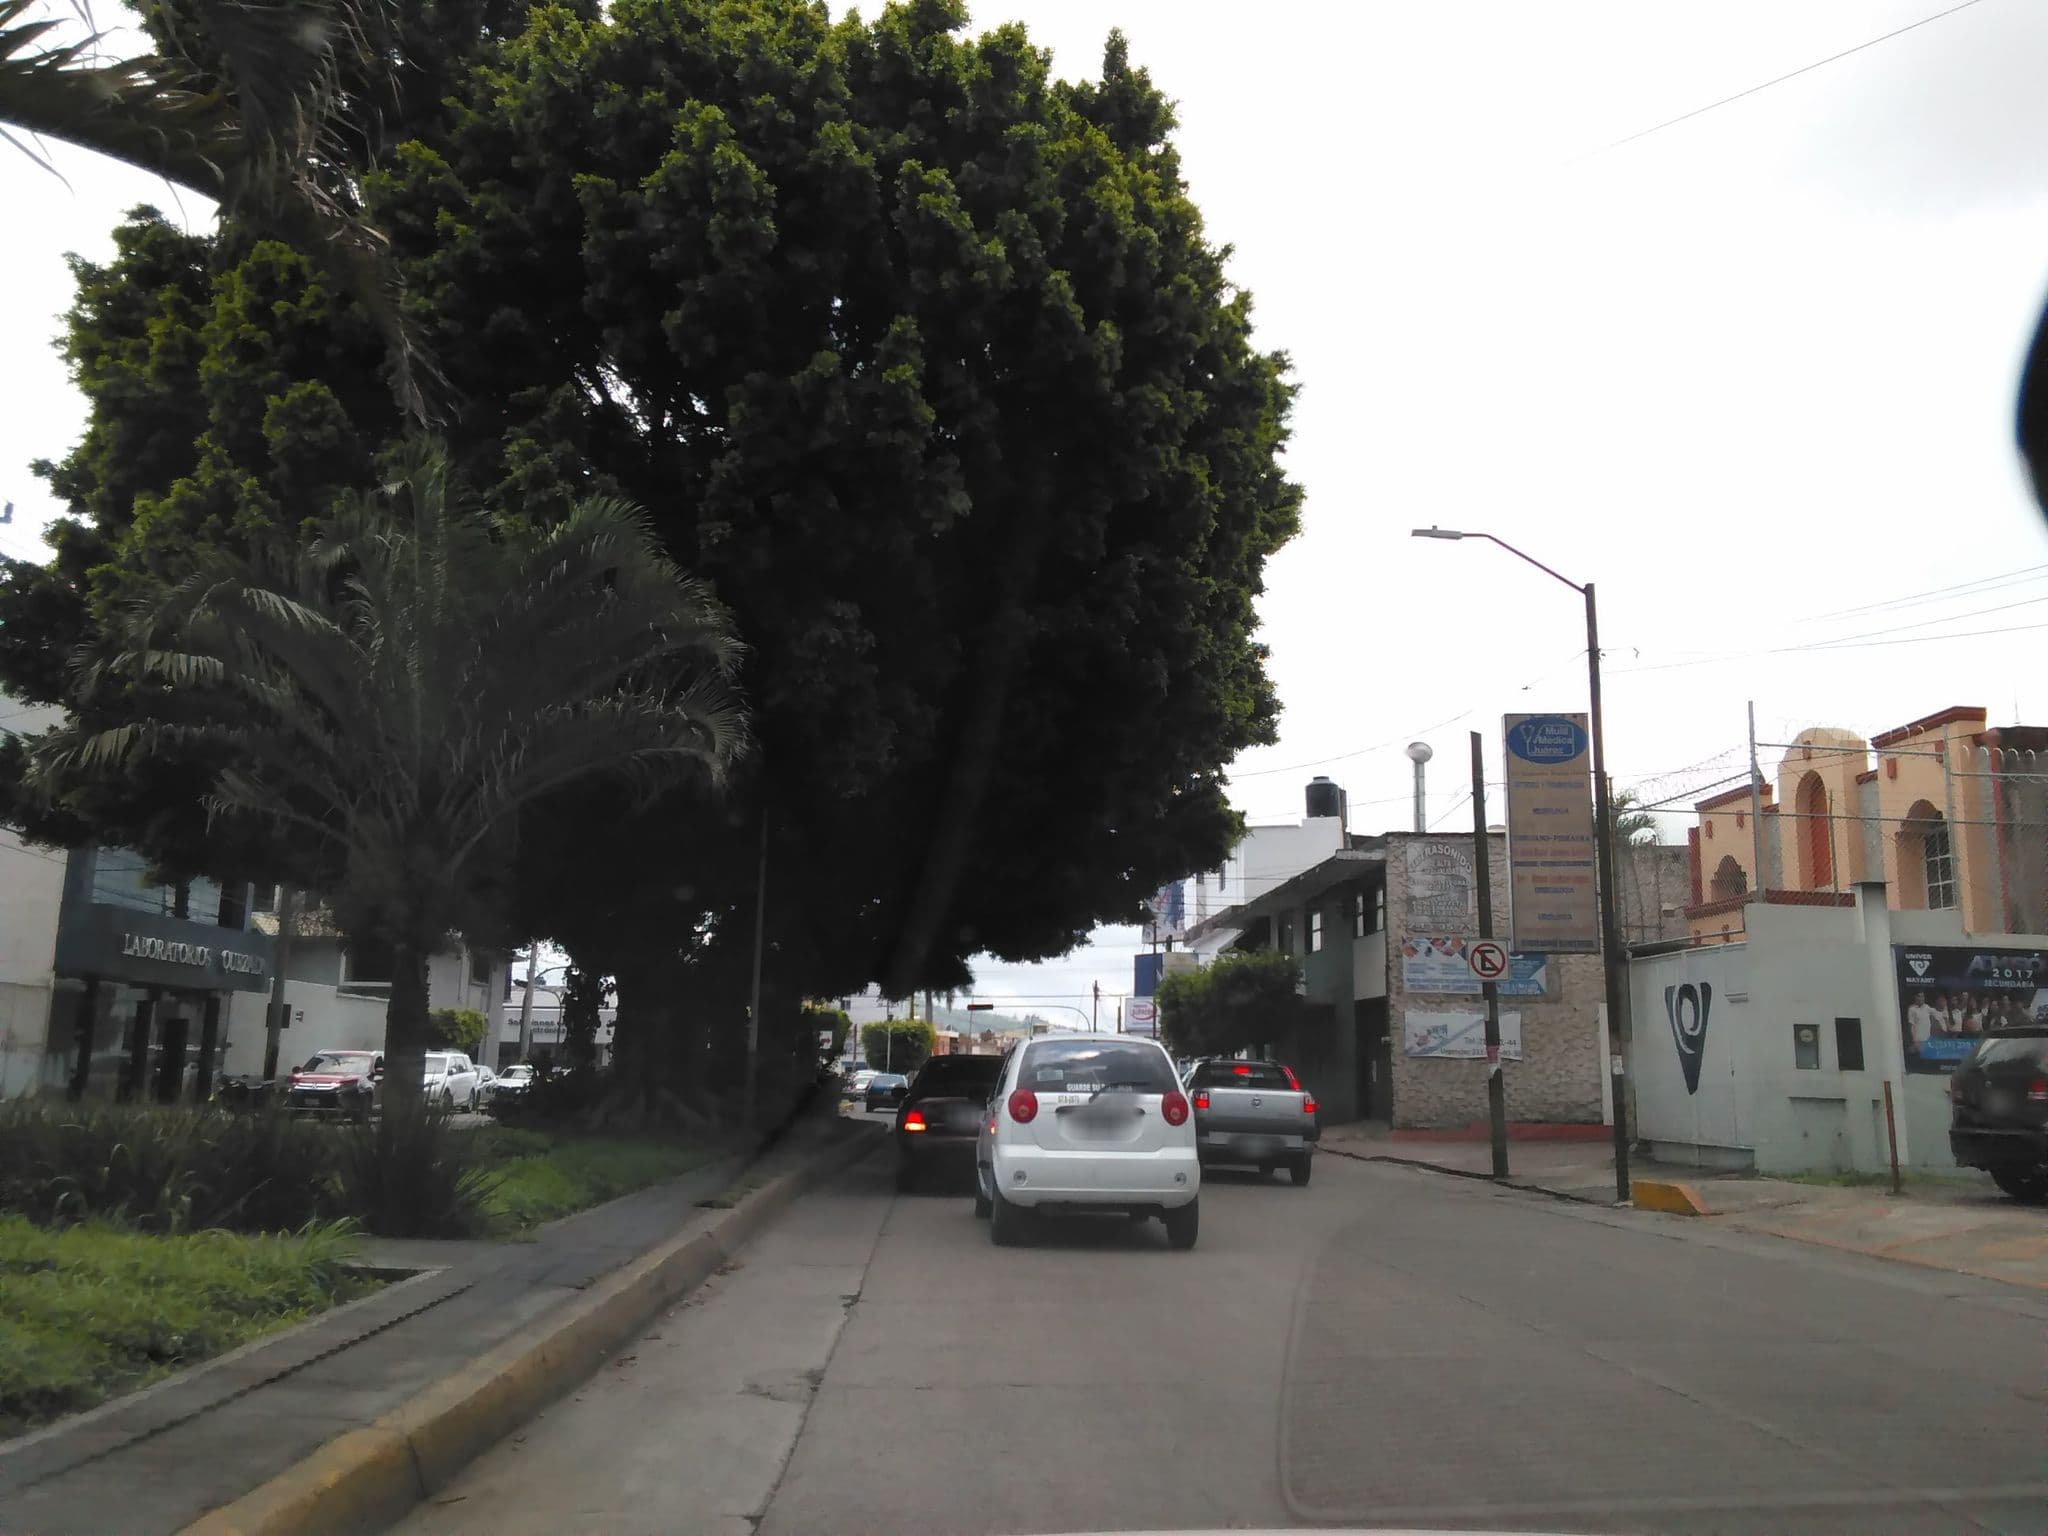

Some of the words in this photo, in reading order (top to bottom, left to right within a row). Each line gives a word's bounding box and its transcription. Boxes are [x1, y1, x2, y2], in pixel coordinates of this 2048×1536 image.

[122, 933, 212, 966] LABORATORIOS
[1992, 968, 2033, 979] 2017
[1984, 980, 2035, 988] SECUNDARIA
